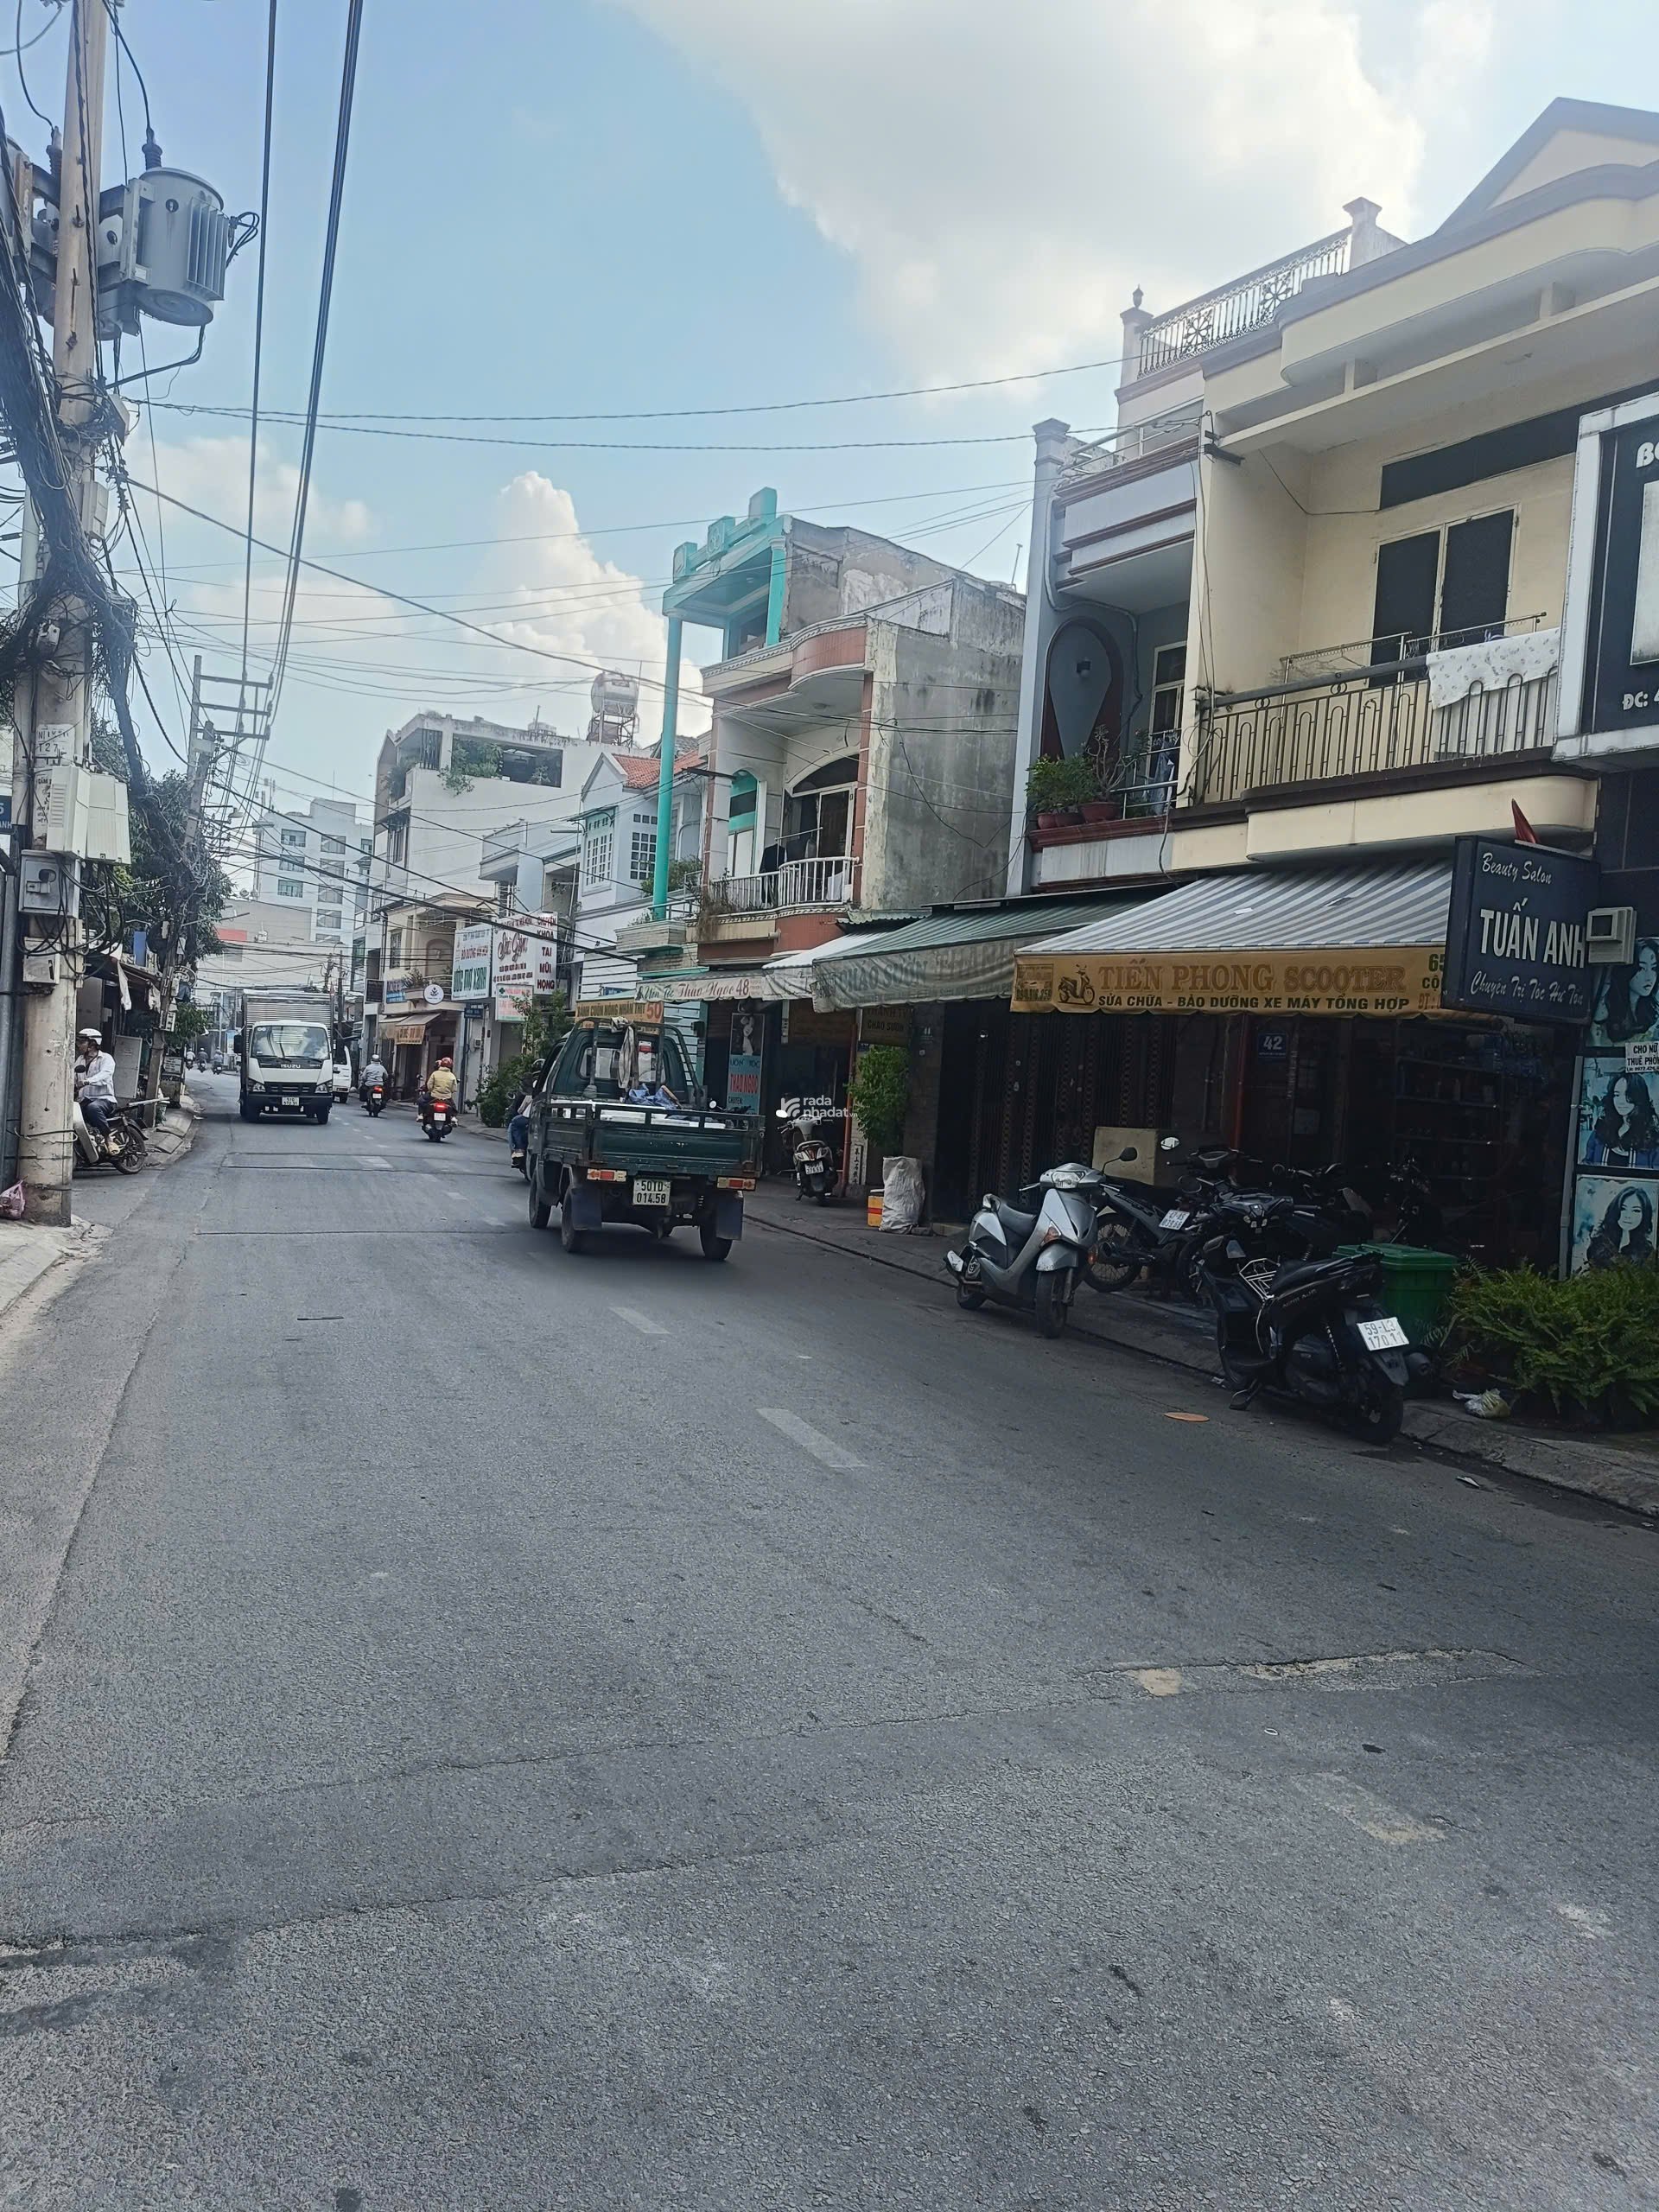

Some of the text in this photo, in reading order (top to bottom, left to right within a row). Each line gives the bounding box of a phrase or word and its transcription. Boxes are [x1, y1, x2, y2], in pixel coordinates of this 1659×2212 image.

[1482, 852, 1553, 885] Beauty Salon
[1480, 898, 1586, 969] TUẤN ANH
[541, 946, 552, 957] TAI
[539, 961, 551, 973] MŨI
[1098, 958, 1407, 994] TIẾN PHONG SCOOTER
[1422, 975, 1440, 991] CỘ
[537, 979, 555, 991] HỌNG
[735, 978, 749, 995] 48
[1471, 970, 1507, 999] Chuyên
[1510, 976, 1525, 1002] Trị
[646, 1002, 662, 1019] 50
[1098, 993, 1122, 1007] SỬA
[1127, 993, 1162, 1007] CHỮA
[1178, 994, 1205, 1007] BẢO
[1210, 995, 1259, 1008] DƯỠNG
[1264, 997, 1281, 1008] XE
[1287, 995, 1320, 1009] MÁY
[1325, 994, 1368, 1009] TỔNG
[1375, 995, 1409, 1013] HỢP
[1263, 1036, 1282, 1051] 42
[1633, 1042, 1658, 1054] CHO NỮ
[1627, 1055, 1643, 1065] THUÊ
[637, 1192, 666, 1204] 014.58
[1363, 1319, 1396, 1336] 59-L3
[1368, 1332, 1405, 1350] 170.11
